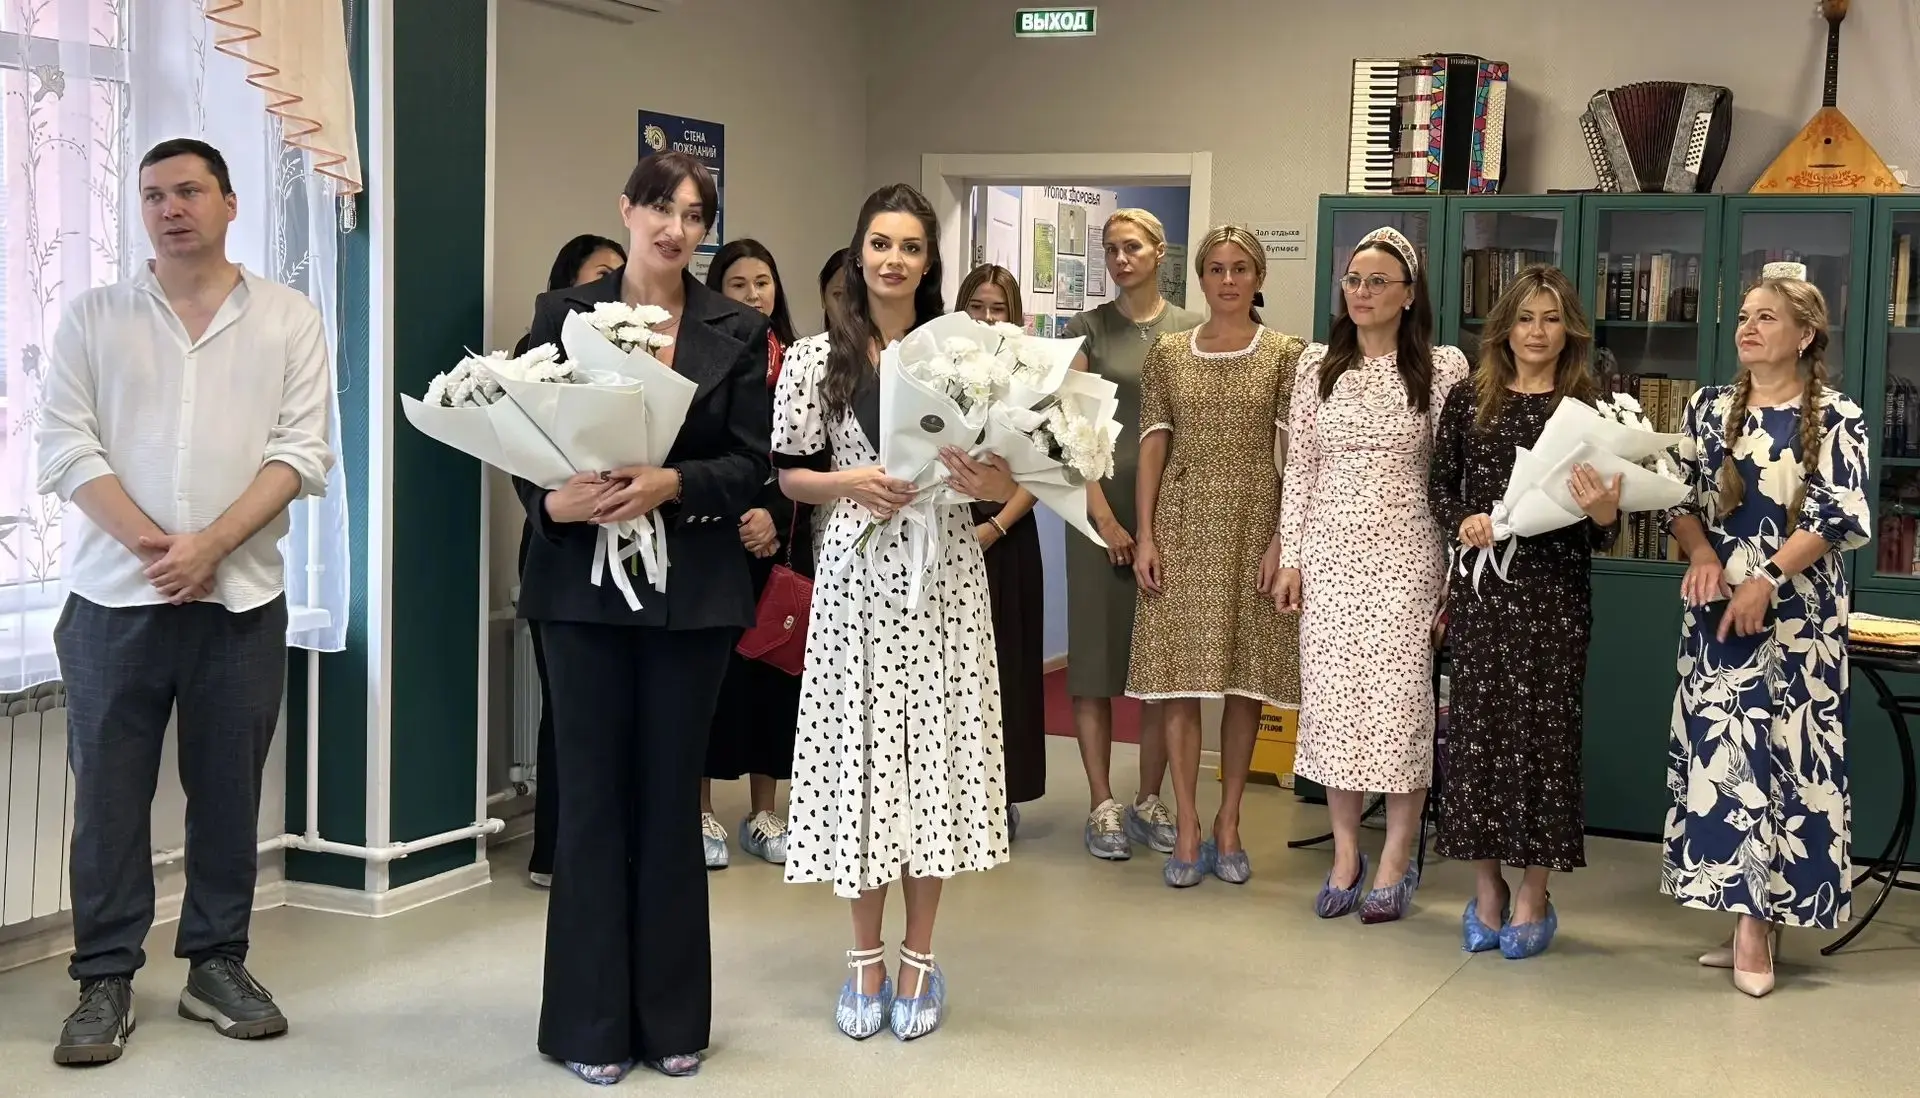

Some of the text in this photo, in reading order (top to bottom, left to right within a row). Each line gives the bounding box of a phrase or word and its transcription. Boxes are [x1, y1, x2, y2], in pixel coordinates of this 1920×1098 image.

[1022, 12, 1088, 31] ВЫХОД
[684, 130, 706, 143] СТЕНА
[673, 142, 717, 158] ПОЖЕЛАНИЙ
[1261, 714, 1283, 723] UTION!
[1264, 724, 1283, 732] FLOOR
